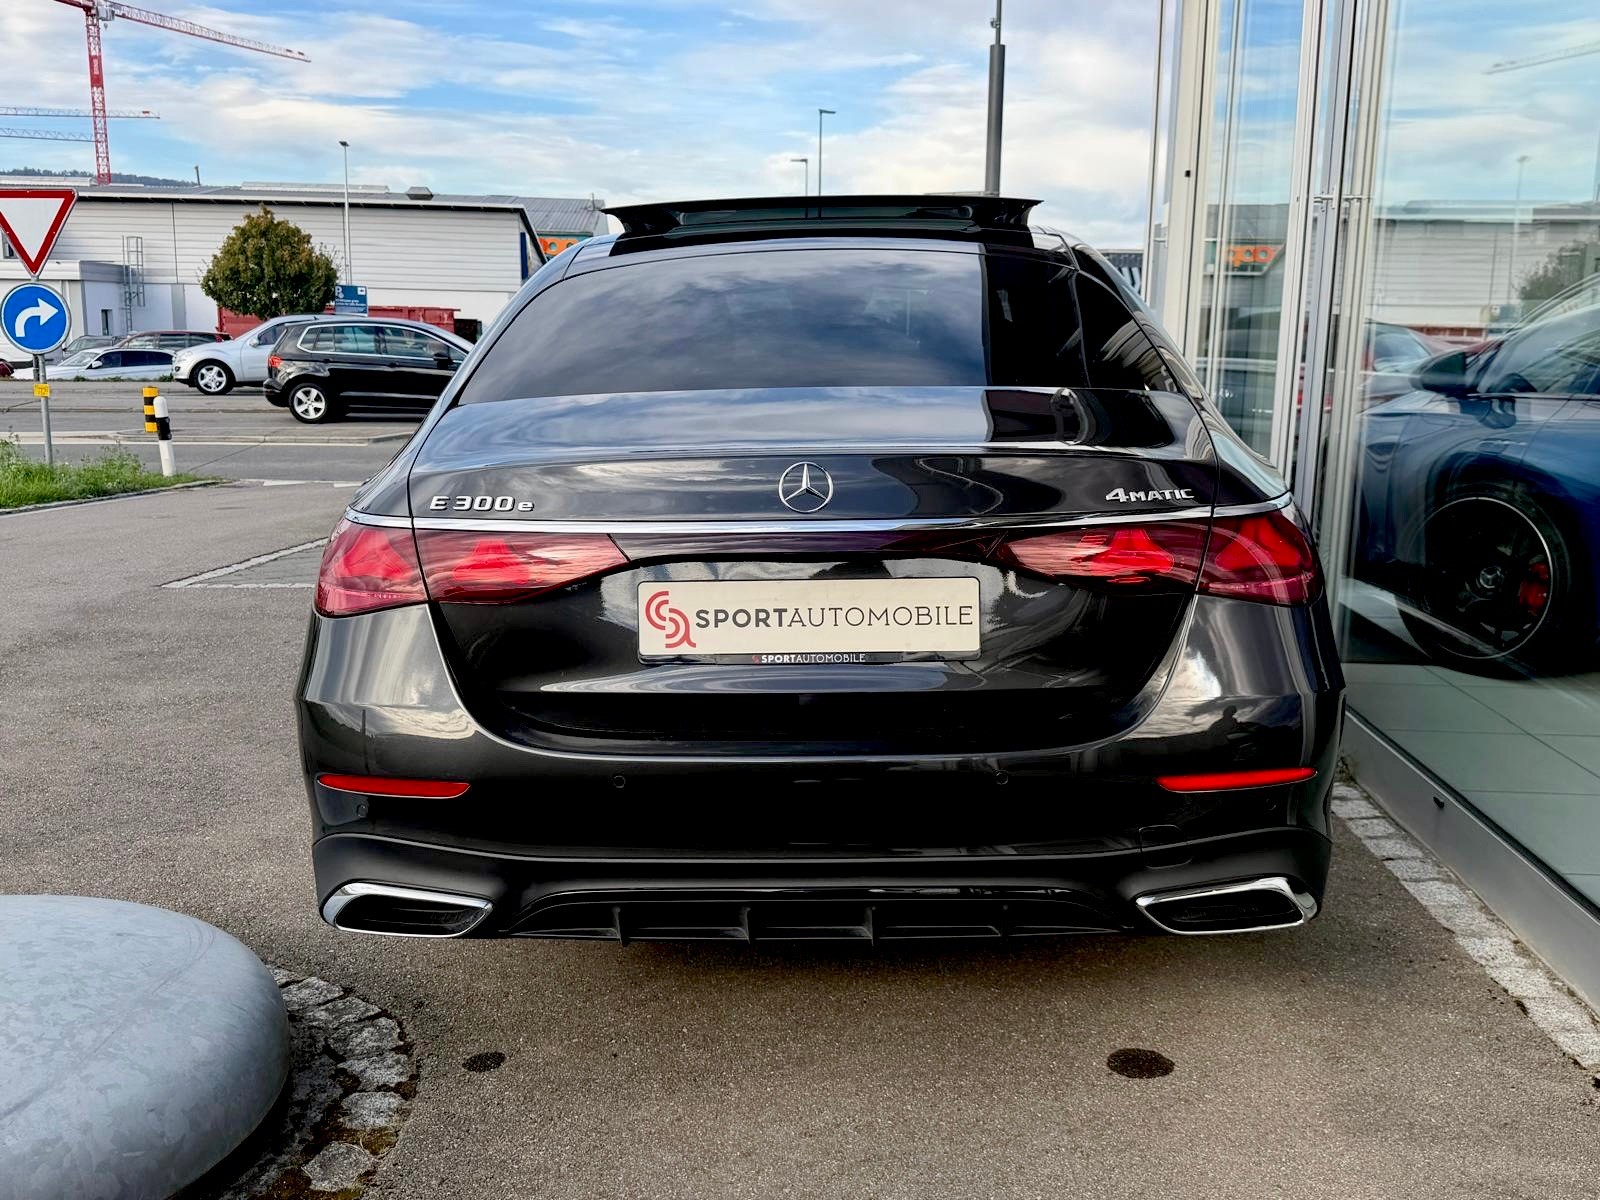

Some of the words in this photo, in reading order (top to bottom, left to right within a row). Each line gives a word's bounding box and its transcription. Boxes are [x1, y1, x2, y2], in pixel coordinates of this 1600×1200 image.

[1105, 487, 1195, 502] 4MATIC
[695, 605, 973, 628] SPORTAUTOMOBILE
[761, 654, 866, 664] SPORTAUTOMOBILE
